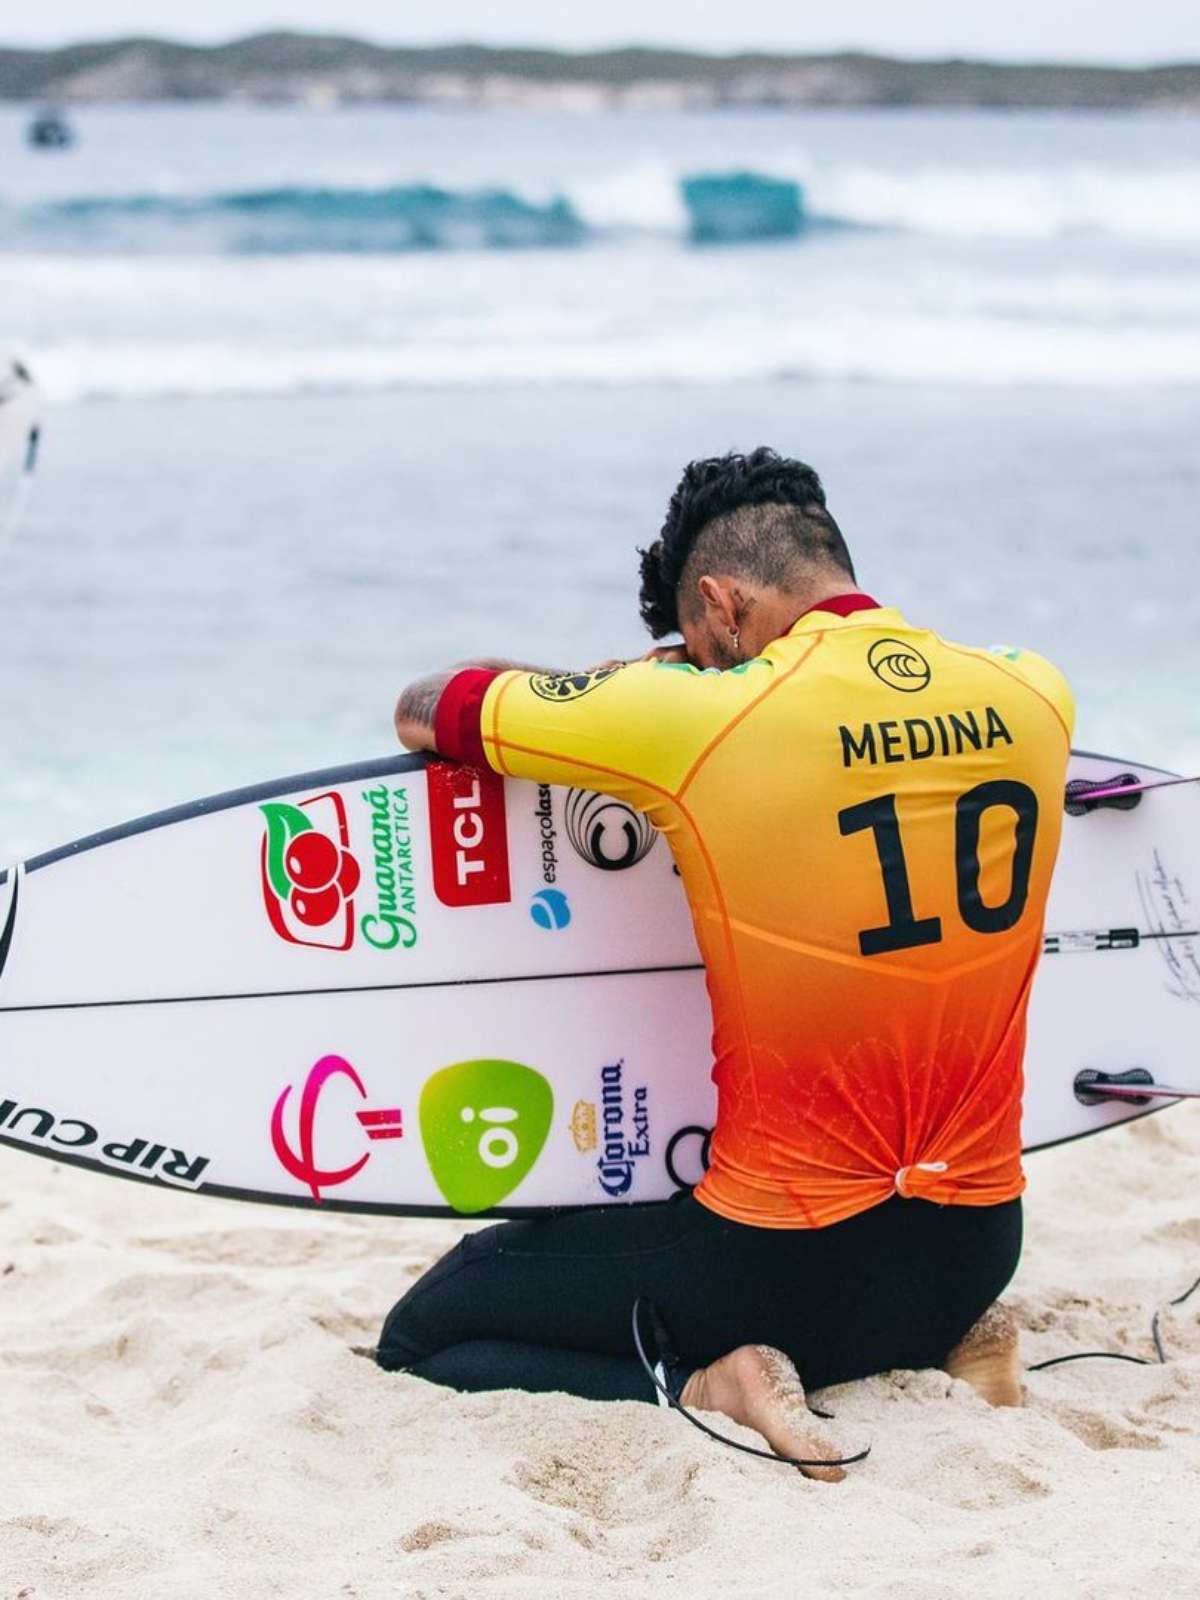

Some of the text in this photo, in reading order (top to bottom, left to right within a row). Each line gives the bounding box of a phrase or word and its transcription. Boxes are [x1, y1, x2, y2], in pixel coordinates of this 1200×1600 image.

[839, 707, 1013, 768] MEDINA
[361, 784, 417, 949] Guaraná
[393, 788, 416, 914] ANTARCTICA
[453, 780, 485, 885] TCL
[838, 780, 1039, 957] 10
[102, 1138, 210, 1181] RIP
[597, 1063, 635, 1197] Corona
[629, 1087, 650, 1157] Extra
